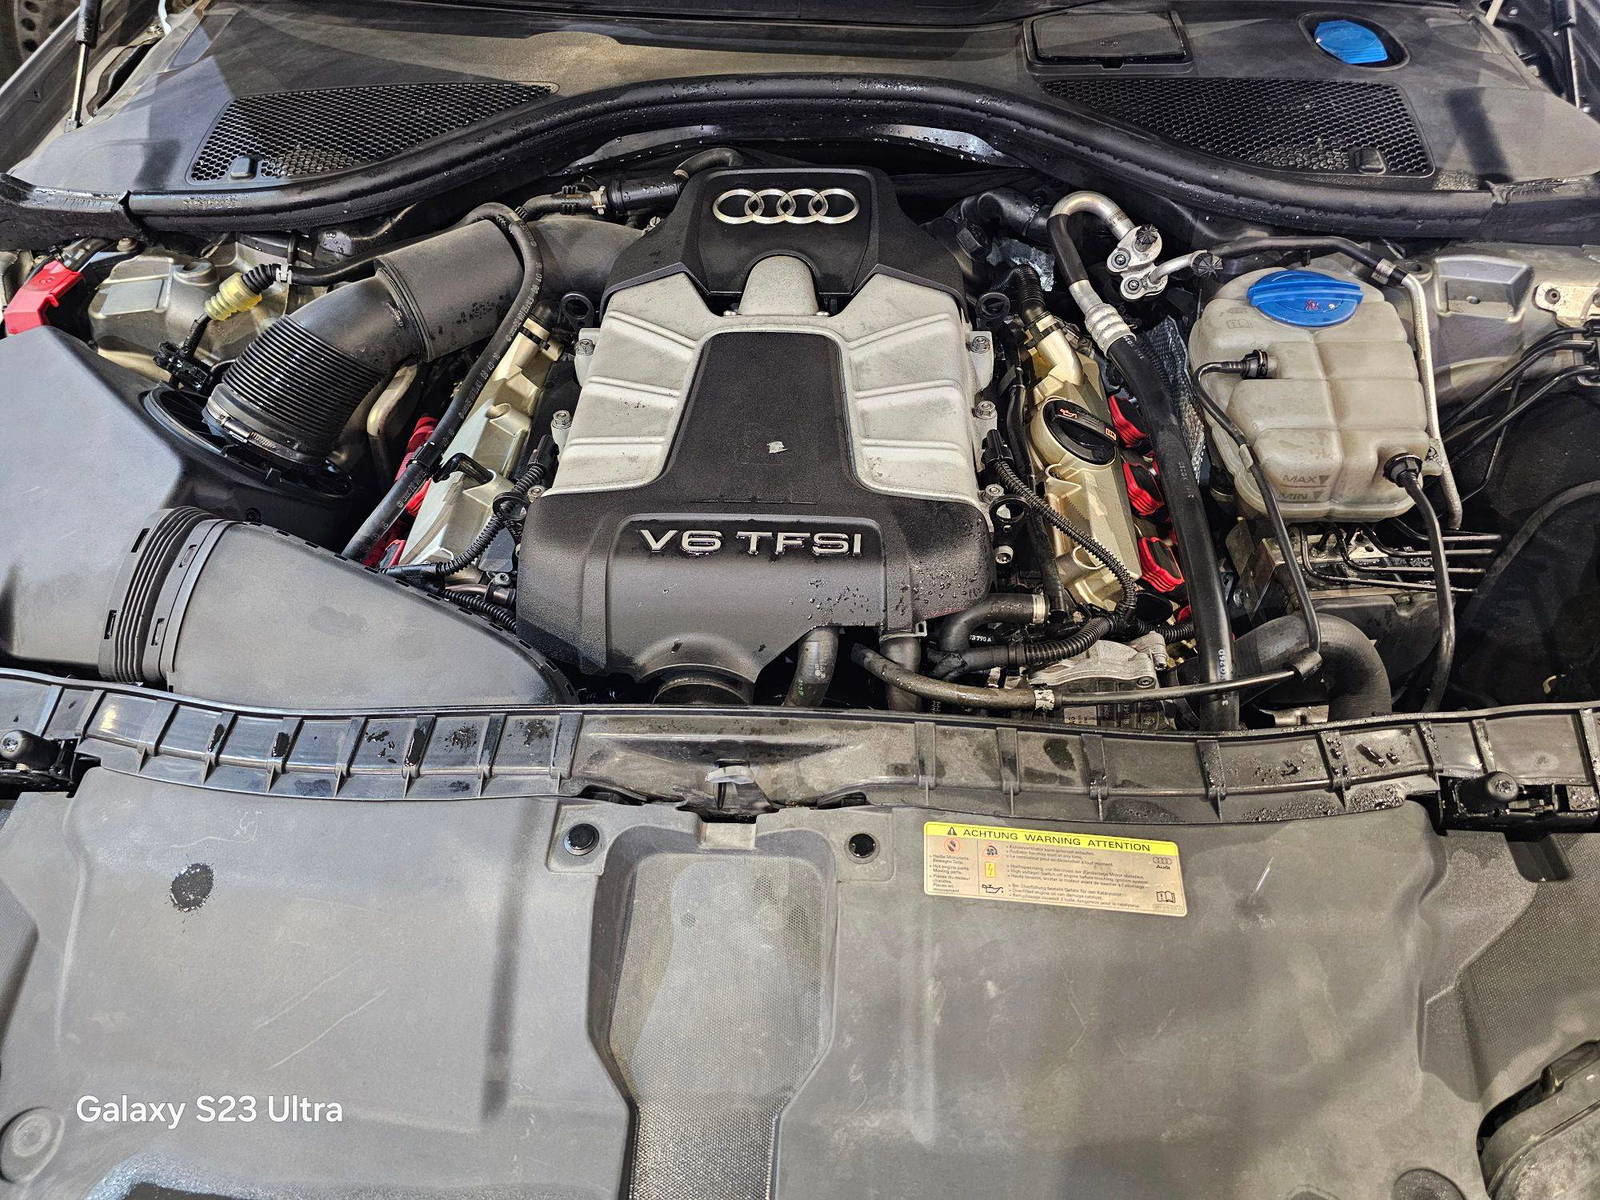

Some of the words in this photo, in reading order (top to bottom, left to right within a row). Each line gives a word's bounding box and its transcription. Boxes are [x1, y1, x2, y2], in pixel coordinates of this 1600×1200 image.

[1282, 474, 1318, 484] MAX
[640, 529, 723, 554] V6
[736, 531, 863, 555] TFSI
[963, 828, 1018, 840] ACHTUNG
[1024, 834, 1081, 846] WARNING
[1087, 839, 1151, 852] ATTENTION
